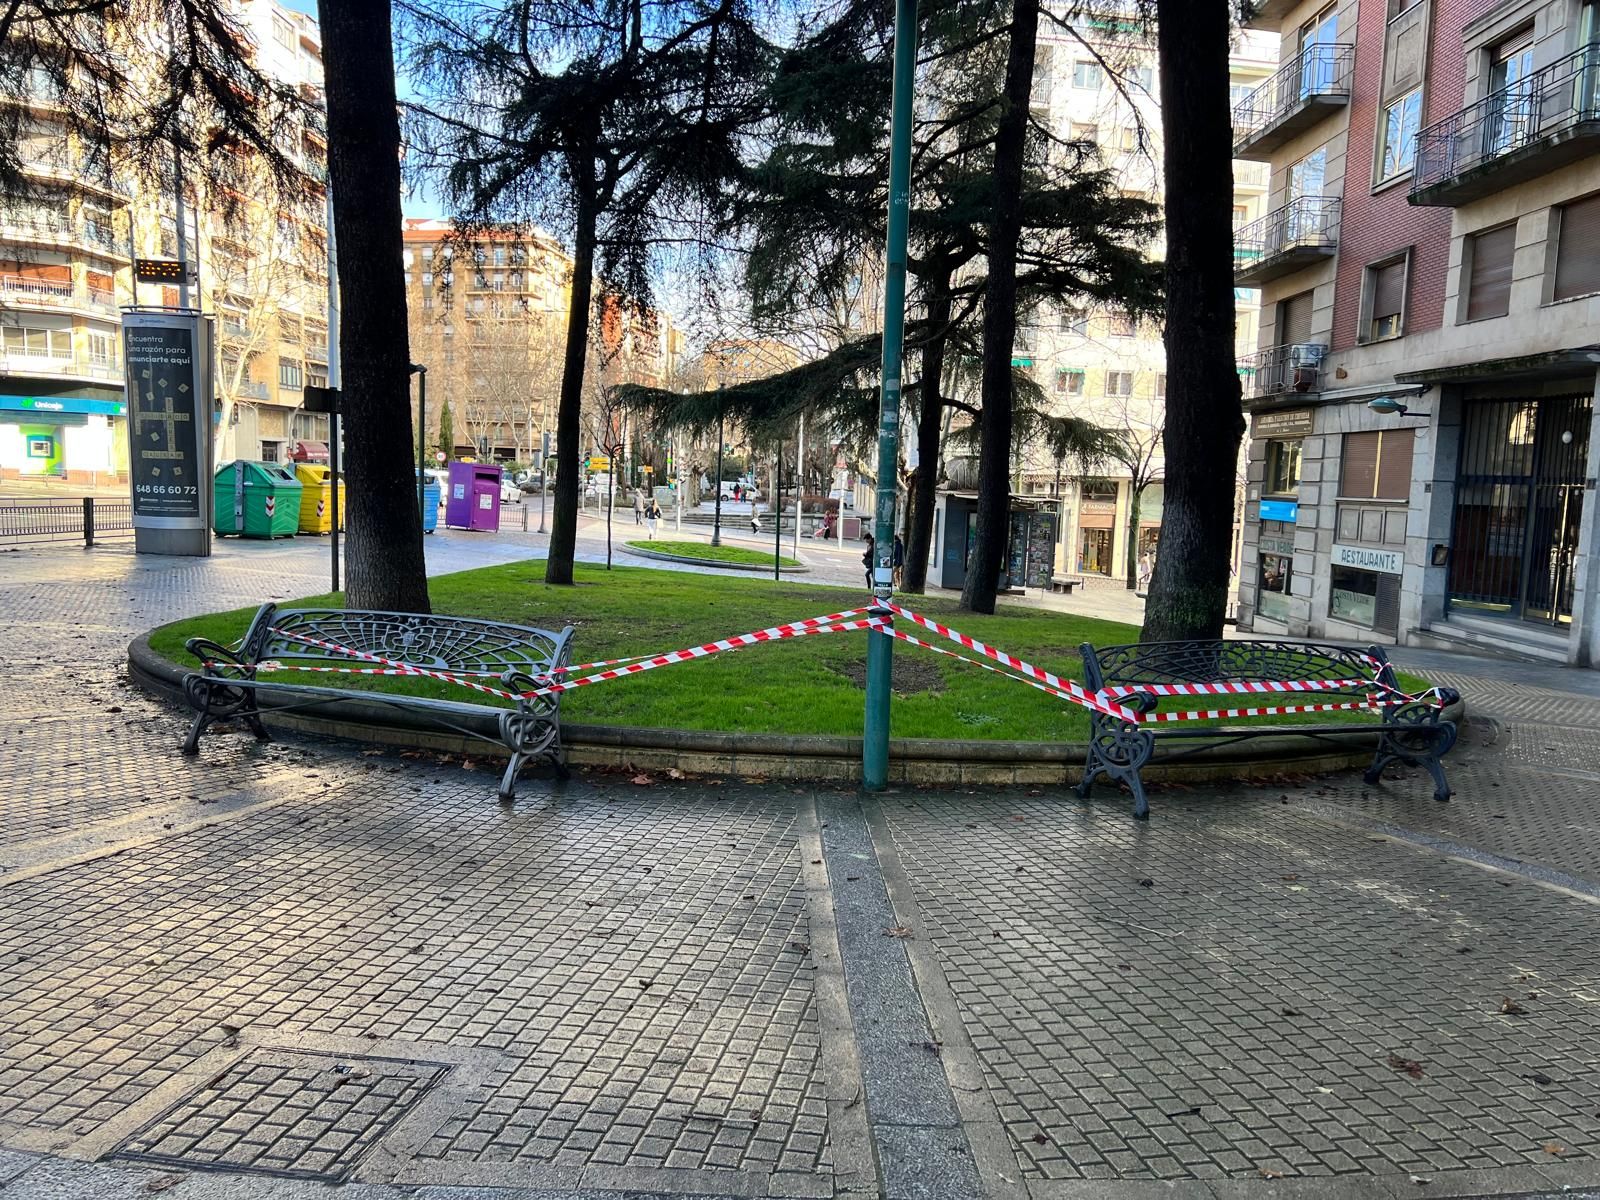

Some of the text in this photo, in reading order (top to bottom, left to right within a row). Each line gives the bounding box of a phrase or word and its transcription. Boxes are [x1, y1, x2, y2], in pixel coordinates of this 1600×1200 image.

[141, 345, 164, 353] razón
[165, 347, 186, 355] para
[128, 355, 169, 364] anunciarte
[136, 484, 198, 495] 648 66 60 72
[1341, 549, 1396, 570] RESTAURANTE
